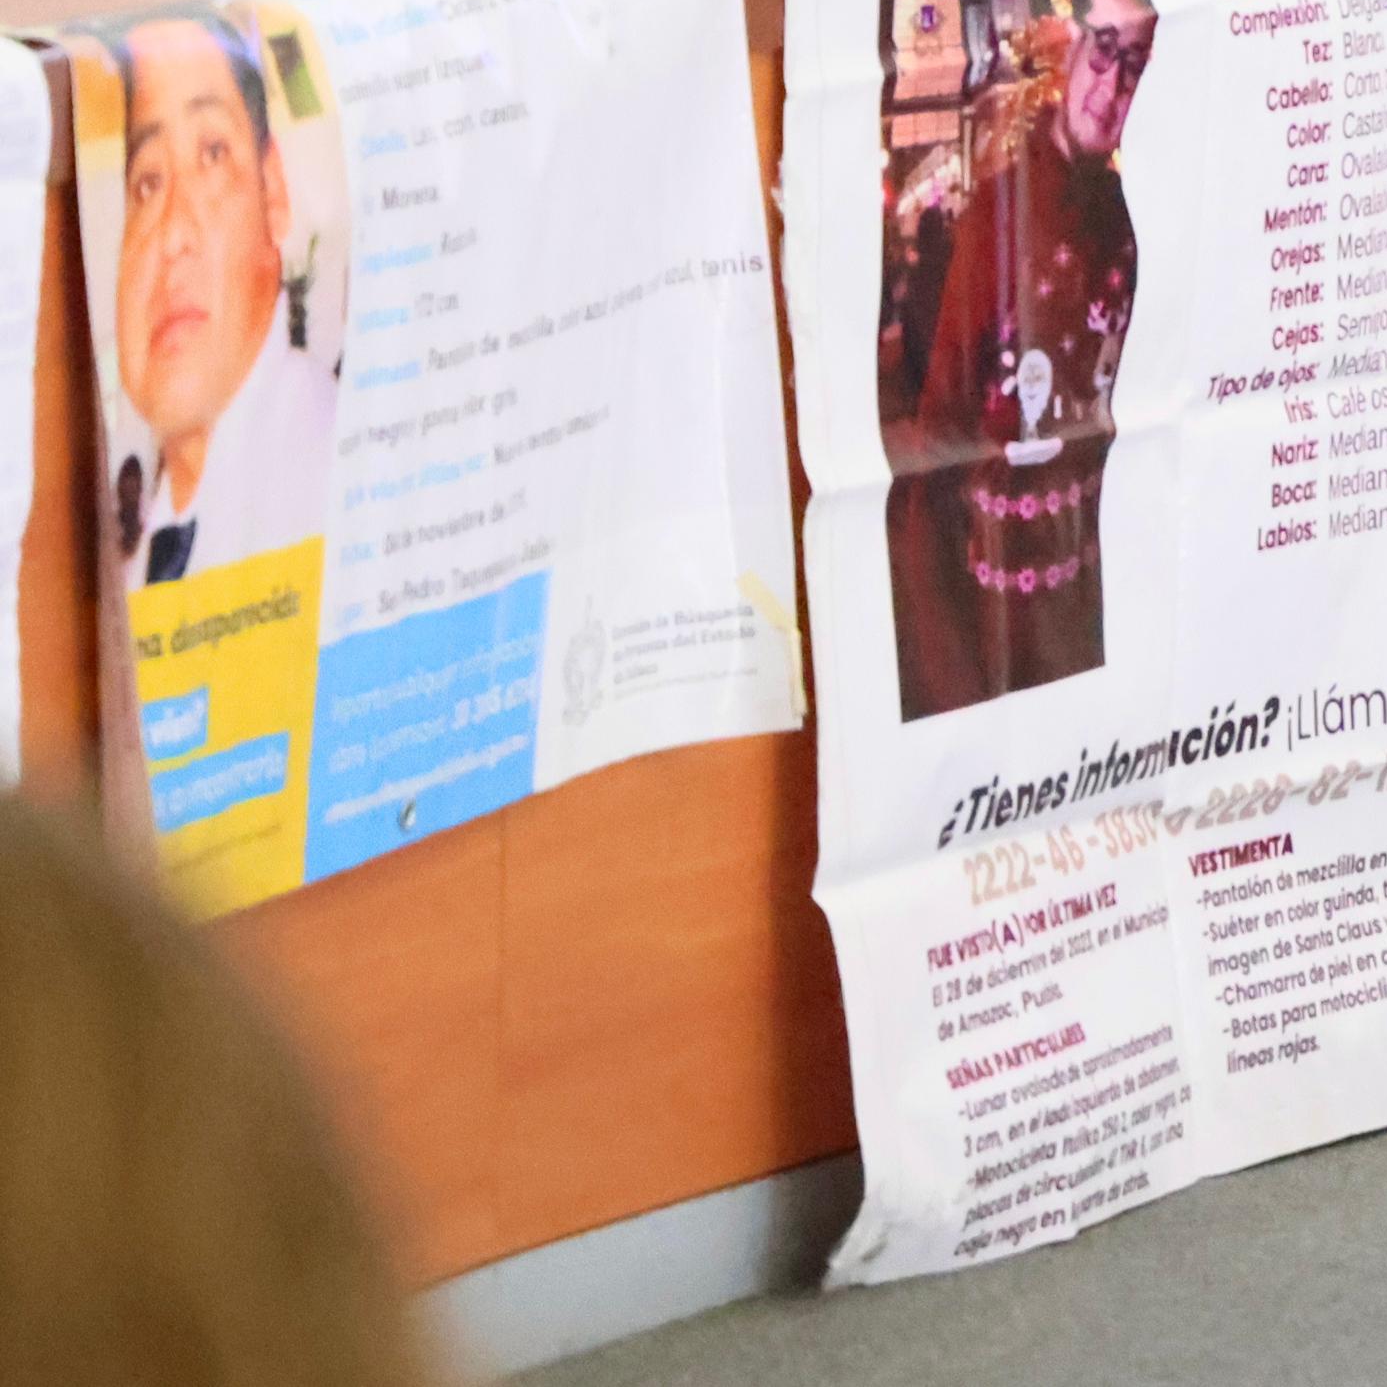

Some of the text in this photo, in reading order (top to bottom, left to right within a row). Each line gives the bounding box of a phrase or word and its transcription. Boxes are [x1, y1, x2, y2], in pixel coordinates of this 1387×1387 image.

[1303, 40, 1332, 63] Tez:
[1287, 122, 1331, 148] Color:
[1288, 163, 1328, 188] Cara:
[1264, 203, 1325, 232] Mentón:
[1271, 243, 1324, 274] Orejas:
[1271, 282, 1323, 311] Frente:
[1272, 324, 1323, 355] Cejas:
[1272, 481, 1316, 508] Boca:
[1258, 519, 1316, 551] Labios:
[1189, 833, 1293, 877] VESTIMENTA
[1197, 875, 1273, 907] -Pantalón
